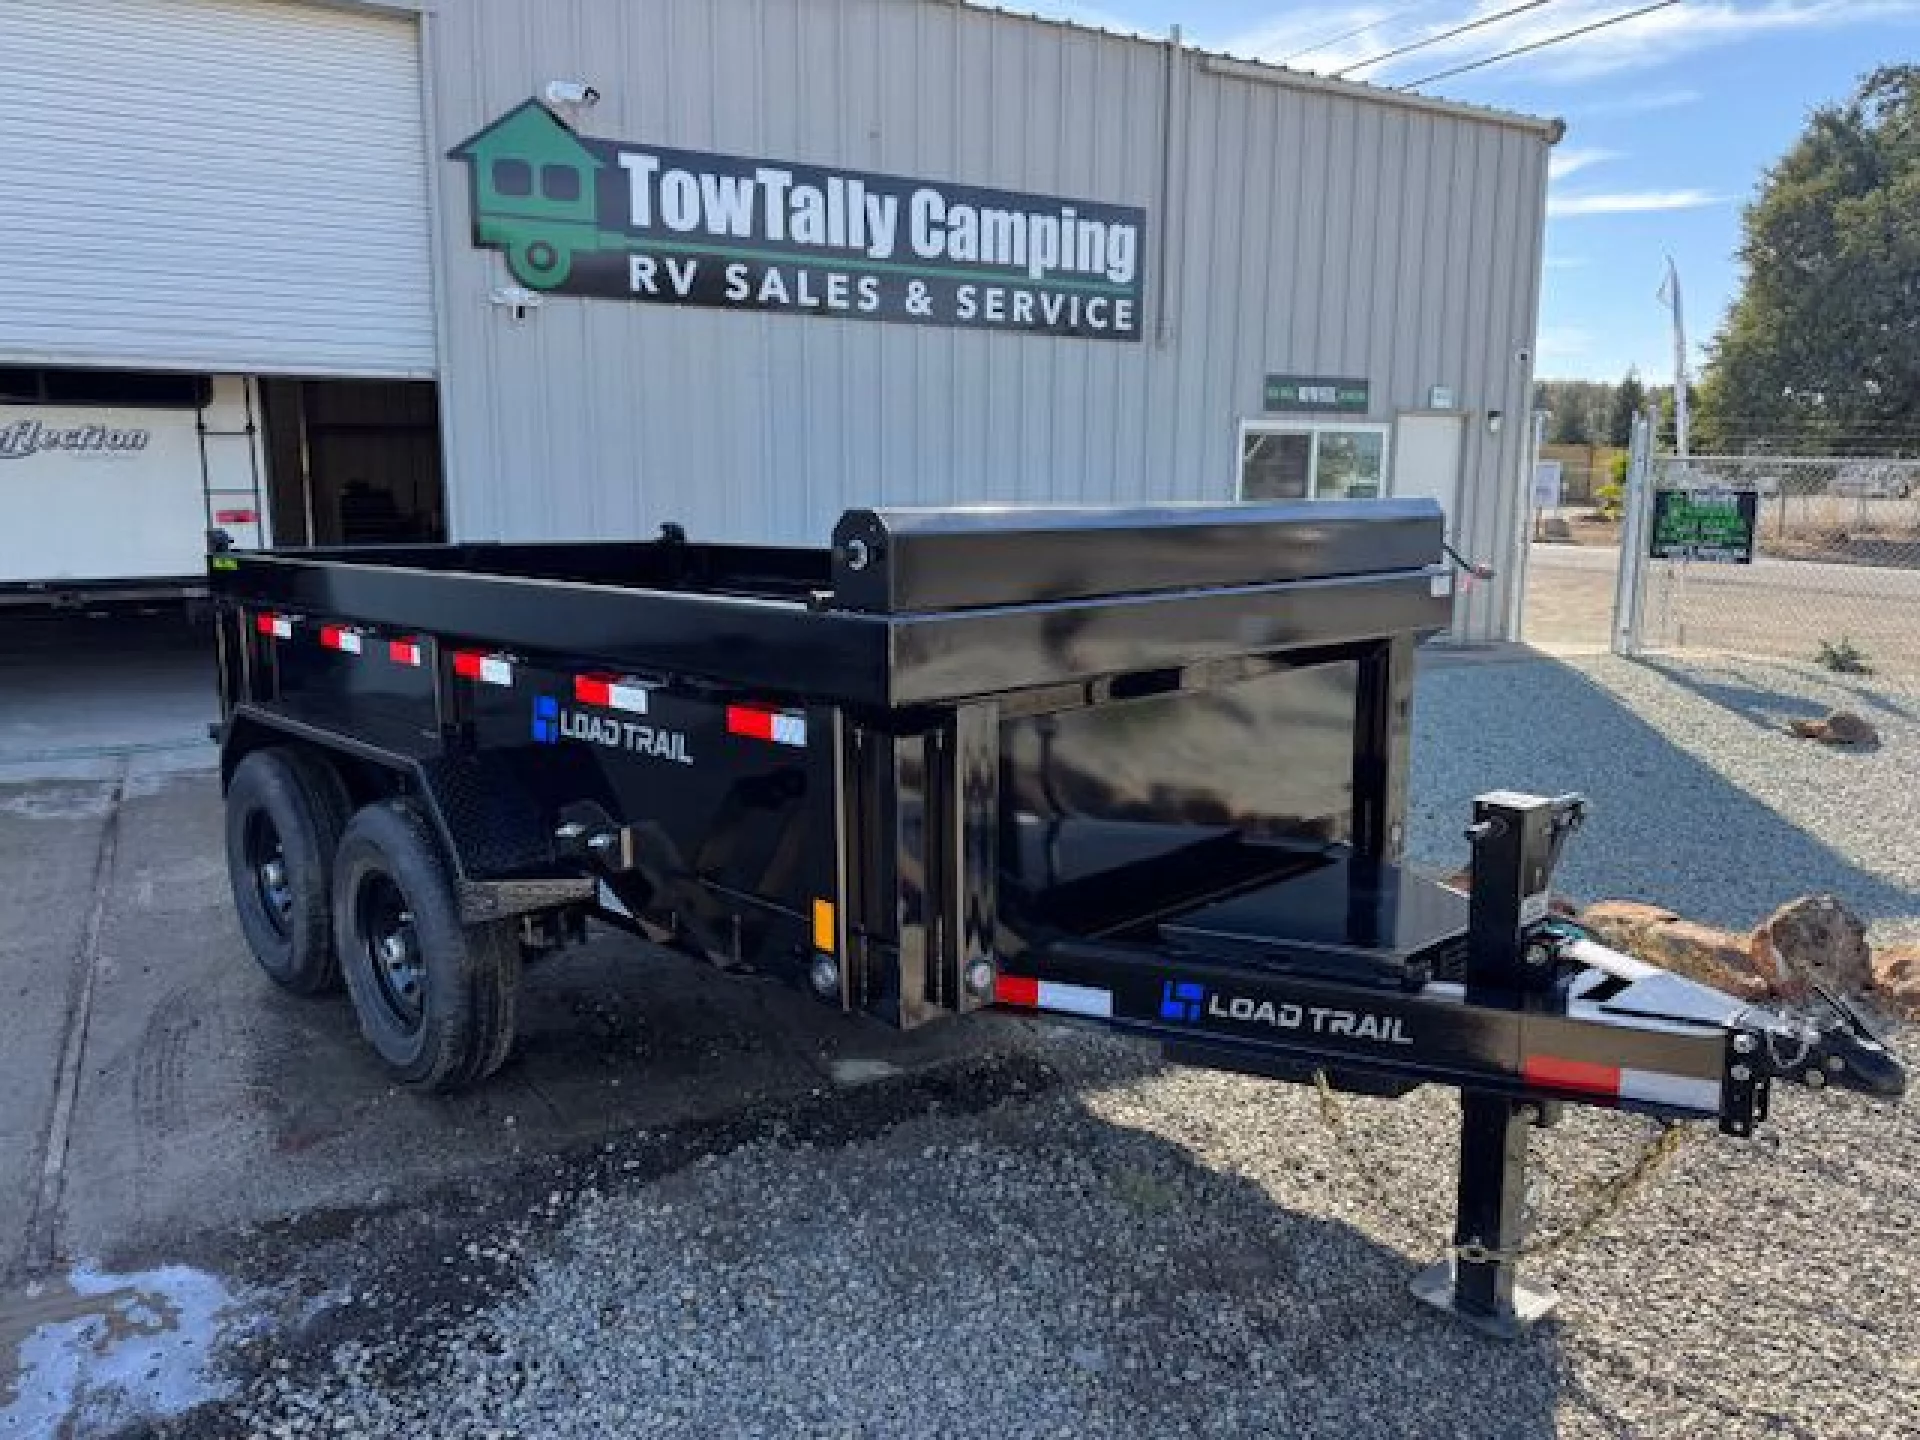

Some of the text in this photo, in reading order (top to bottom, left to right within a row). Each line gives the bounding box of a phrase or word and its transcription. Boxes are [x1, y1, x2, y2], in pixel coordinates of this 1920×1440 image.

[618, 153, 1137, 282] TowTally Camping
[629, 254, 1134, 331] RV SALES & SERVICE
[560, 710, 694, 766] LOAD TRAIL
[1208, 993, 1414, 1045] LOAD TRAIL
